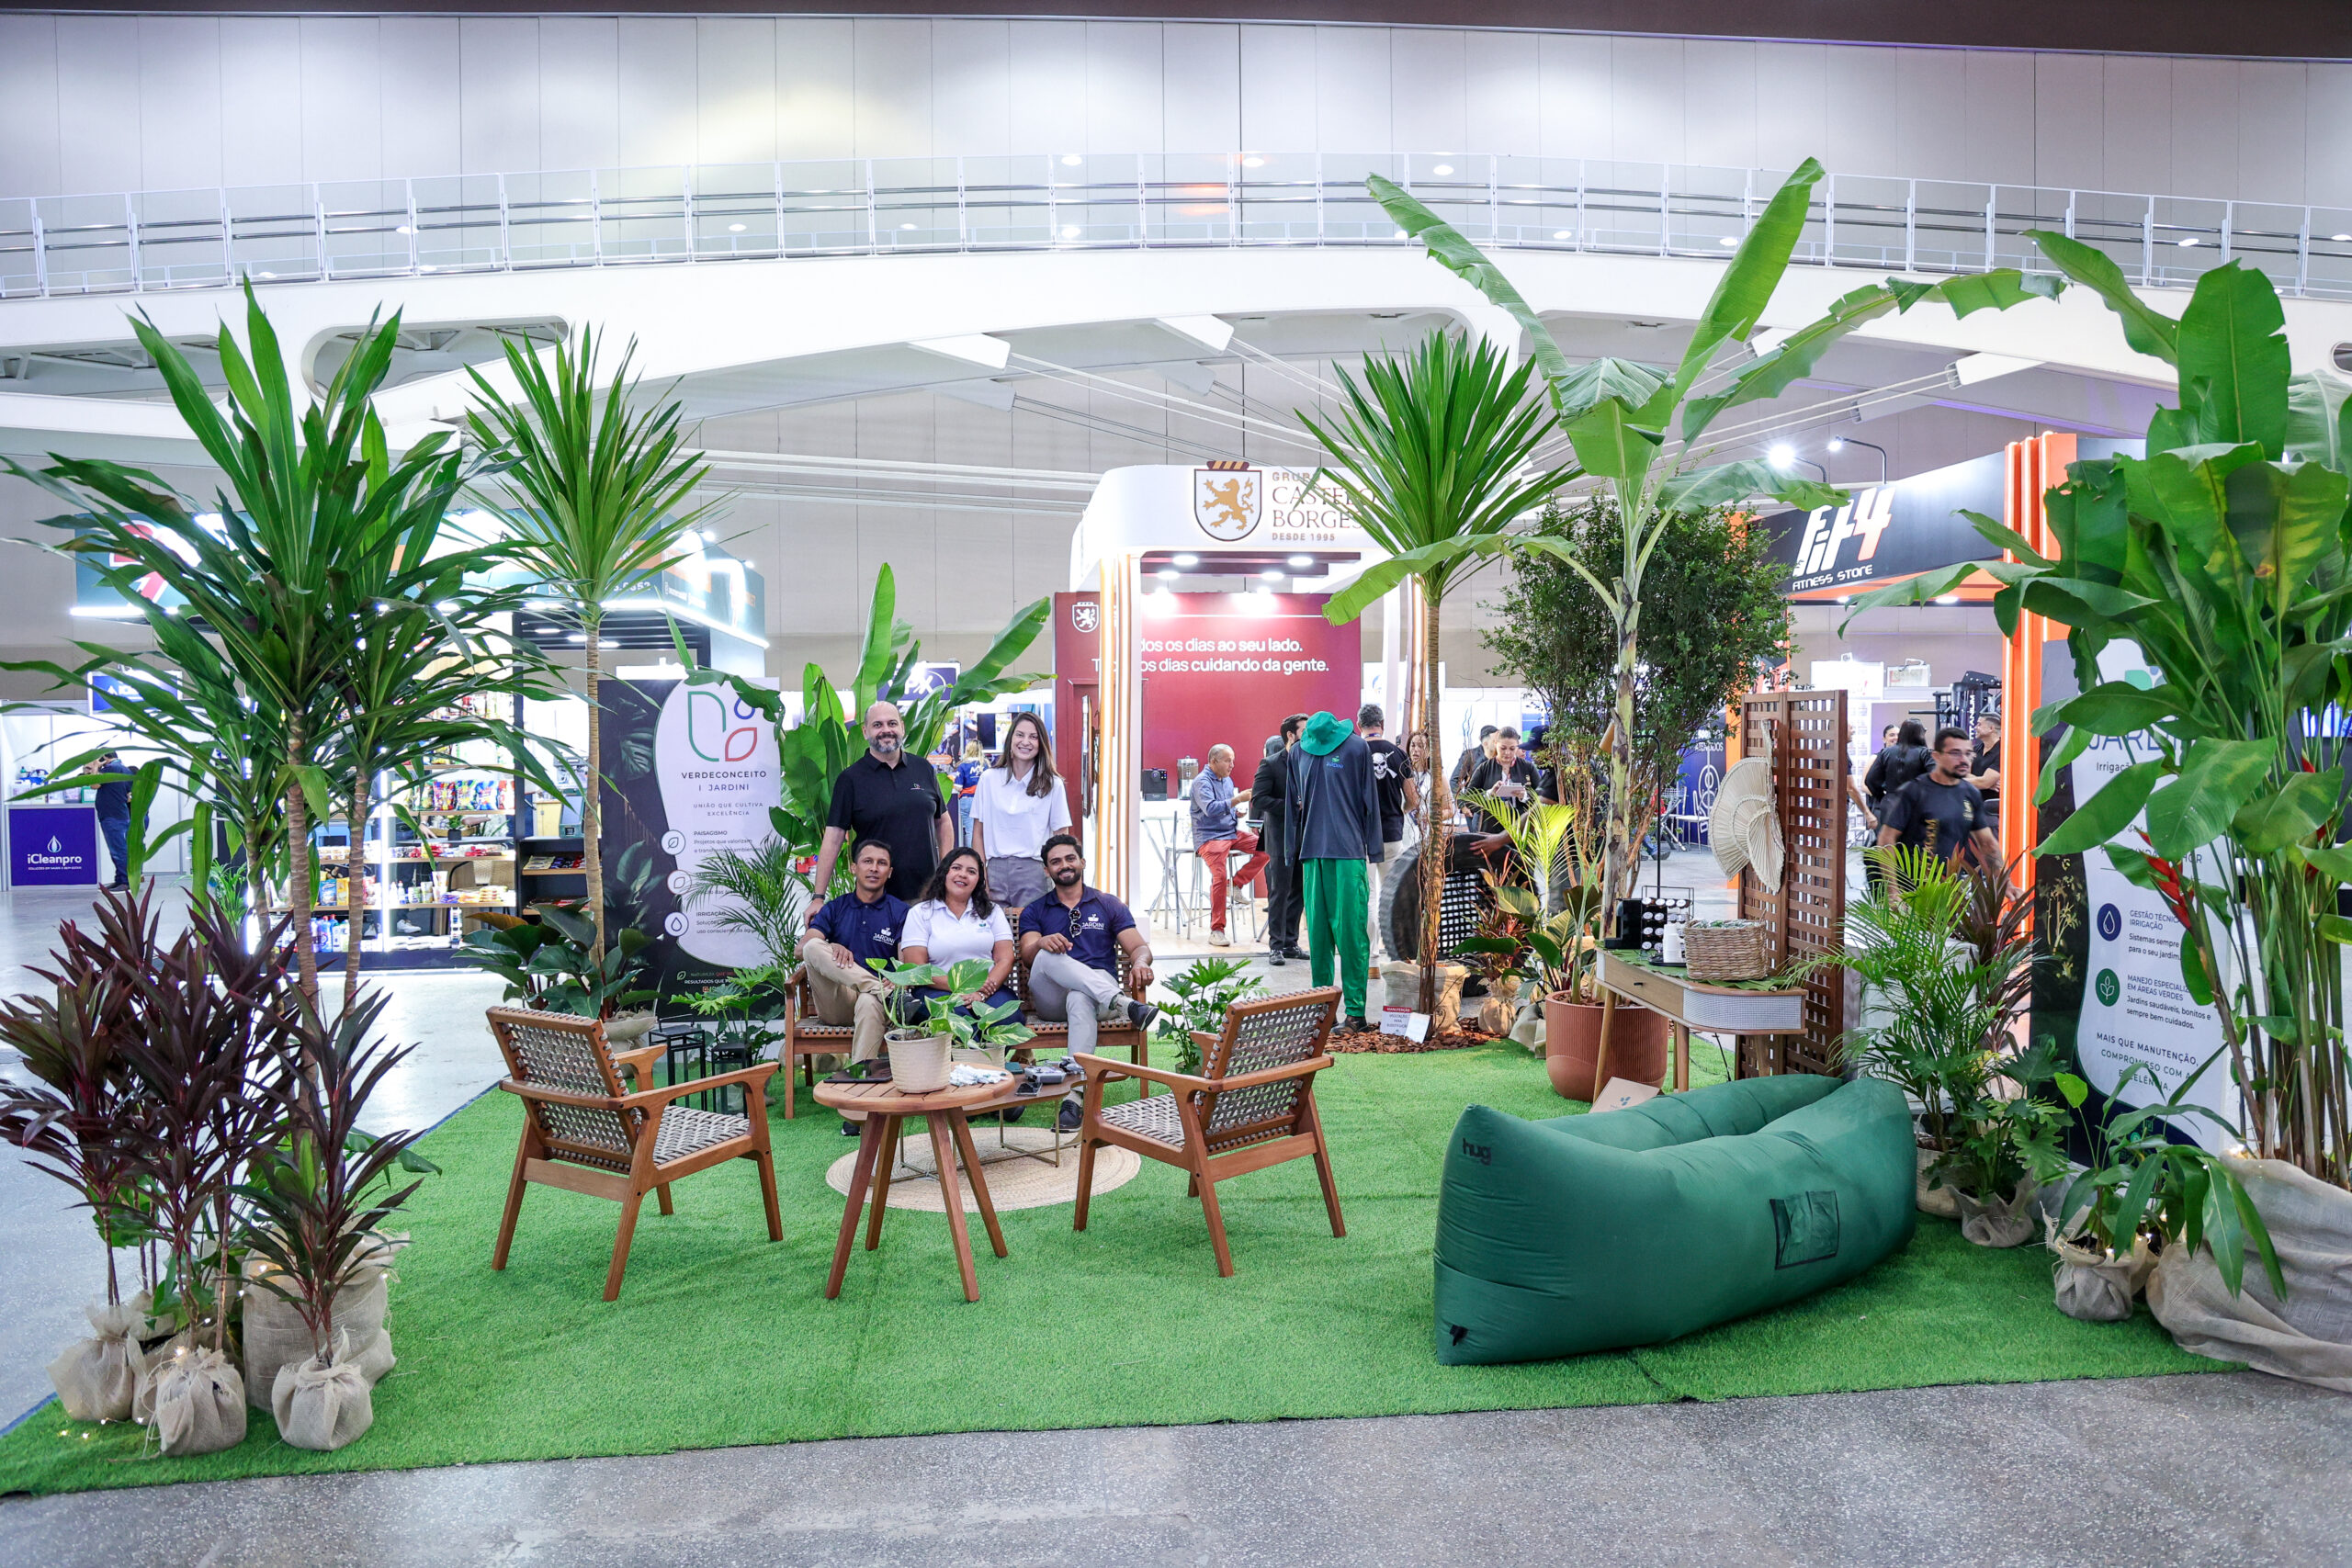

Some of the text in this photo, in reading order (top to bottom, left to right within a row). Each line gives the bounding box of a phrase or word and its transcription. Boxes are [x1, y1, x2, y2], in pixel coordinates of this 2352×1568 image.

[1272, 471, 1320, 482] GRUP
[1272, 533, 1335, 541] DESDE 1995
[1792, 564, 1872, 591] FITNESS STORE
[1165, 640, 1183, 652] os
[1185, 637, 1215, 652] dias
[1217, 640, 1236, 652] ao
[1238, 640, 1265, 652] seu
[1268, 637, 1303, 652] lado.
[1159, 658, 1190, 672] dias
[1192, 658, 1260, 672] cuidando
[1262, 658, 1281, 672] da
[1283, 658, 1329, 675] gente.
[681, 771, 767, 780] VERDECONCEITO
[27, 853, 83, 866] iCleanpro
[2130, 909, 2180, 924] GESTÃO TÉCNIC
[2130, 919, 2163, 931] IRRIGAÇÃO
[2129, 933, 2180, 949] Sistemas sempre
[2129, 946, 2142, 954] para
[2159, 952, 2181, 961] jardim.
[2127, 983, 2183, 1000] EM ÁREAS VERDES
[2128, 975, 2190, 993] MANEJO ESPECIALIZ
[2127, 996, 2148, 1006] Jardins
[2149, 999, 2180, 1014] saudáveis,
[2181, 1007, 2205, 1020] bonitos
[2126, 1008, 2195, 1029] sempre bem cuidados.
[2097, 1032, 2199, 1066] MAIS QUE MANUTENÇÃO,
[2163, 1066, 2182, 1077] COM
[2119, 1069, 2171, 1091] ECELÊNIA.
[1463, 1137, 1491, 1166] hug
